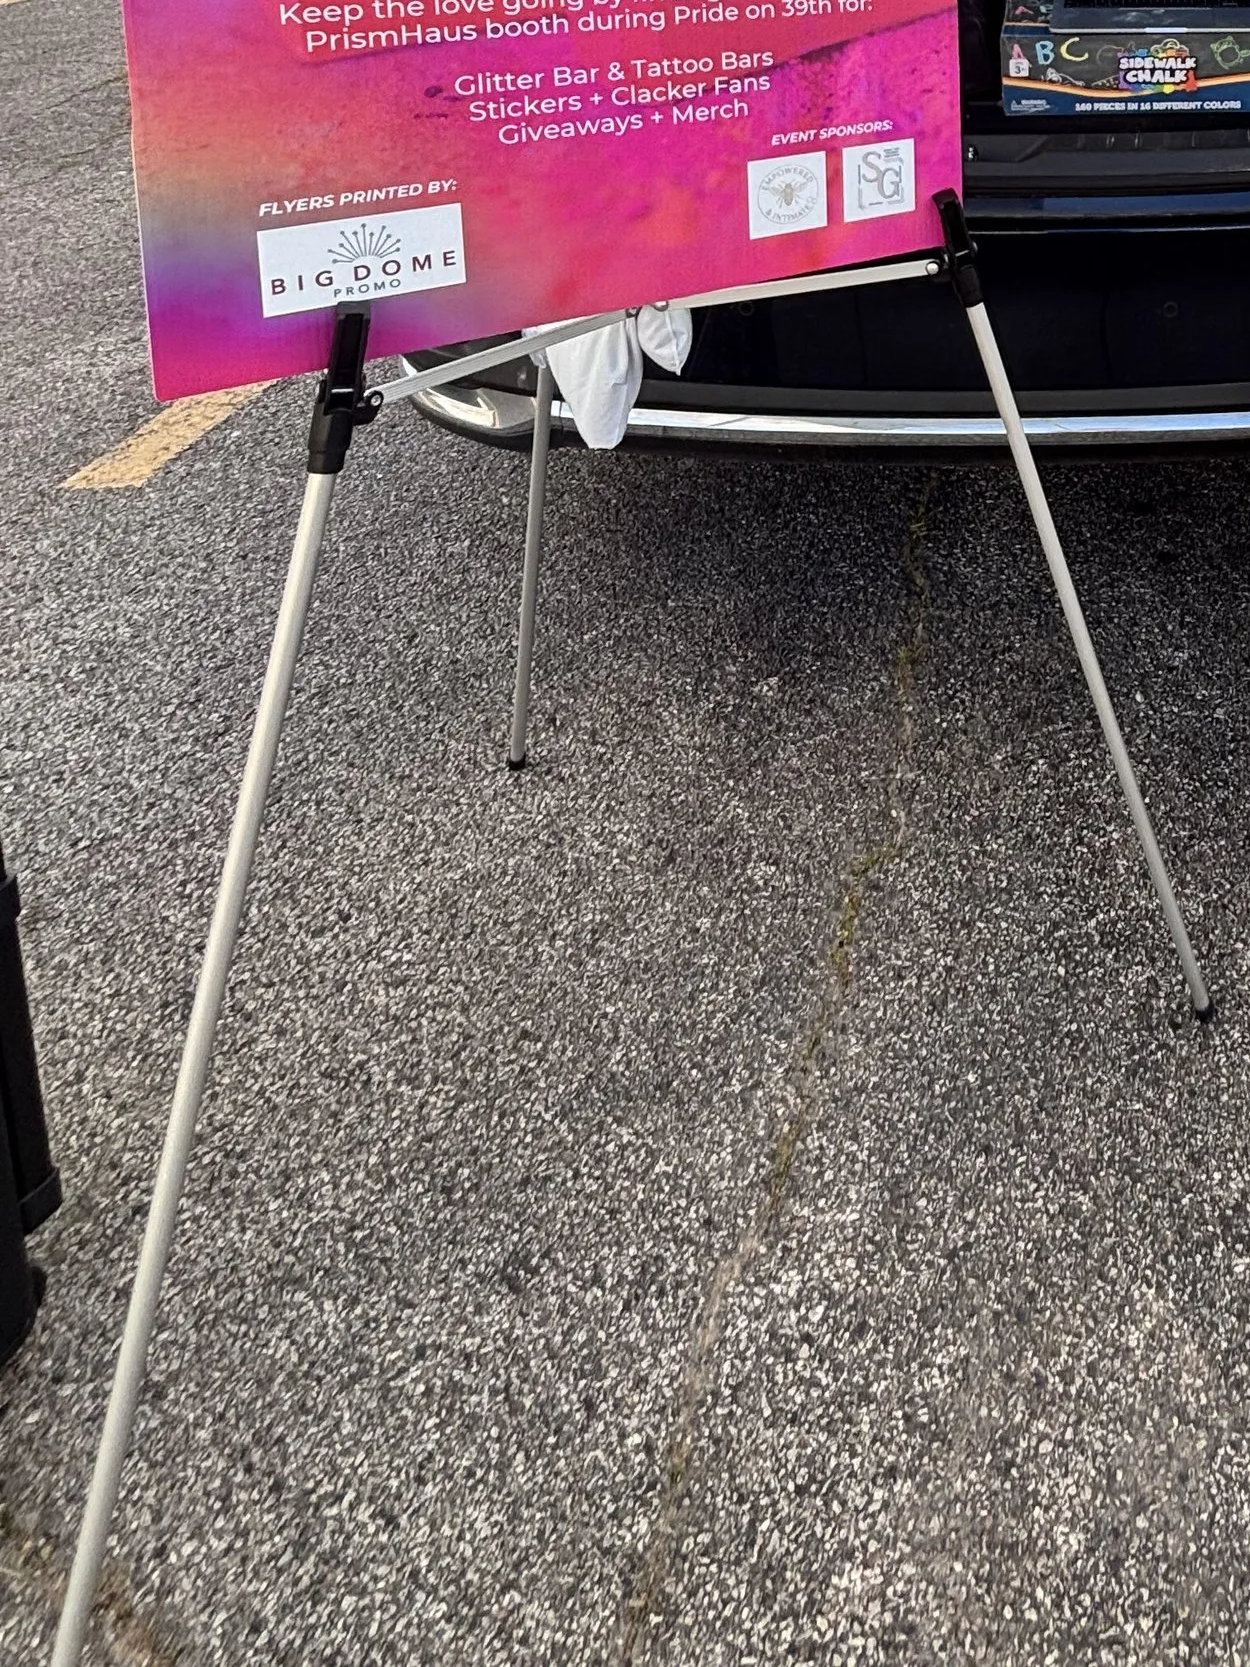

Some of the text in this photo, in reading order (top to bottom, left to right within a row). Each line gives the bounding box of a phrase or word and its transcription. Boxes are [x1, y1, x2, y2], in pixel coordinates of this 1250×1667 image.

[279, 2, 364, 27] Keep
[305, 23, 478, 53] PrismHaus
[485, 13, 570, 40] booth
[577, 7, 667, 33] during
[674, 1, 739, 26] Pride
[744, 3, 776, 20] on
[453, 51, 774, 96] Glitter Bar & Tattoo Bars
[1119, 57, 1197, 70] SIDEWALK
[1125, 70, 1187, 84] CHALK
[468, 94, 583, 123] Stickers
[610, 80, 707, 106] Clacker
[714, 75, 771, 96] Fans
[1075, 100, 1242, 111] 160 PIECES IN 16 DIFFERENT COLORS
[498, 113, 644, 145] Giveaways
[672, 97, 749, 126] Merch
[770, 119, 894, 147] EVENT SPONSORS:
[258, 178, 459, 217] FLYERS PRINTED BY:
[271, 251, 457, 295] BIG DOME
[333, 278, 401, 298] PROMO
